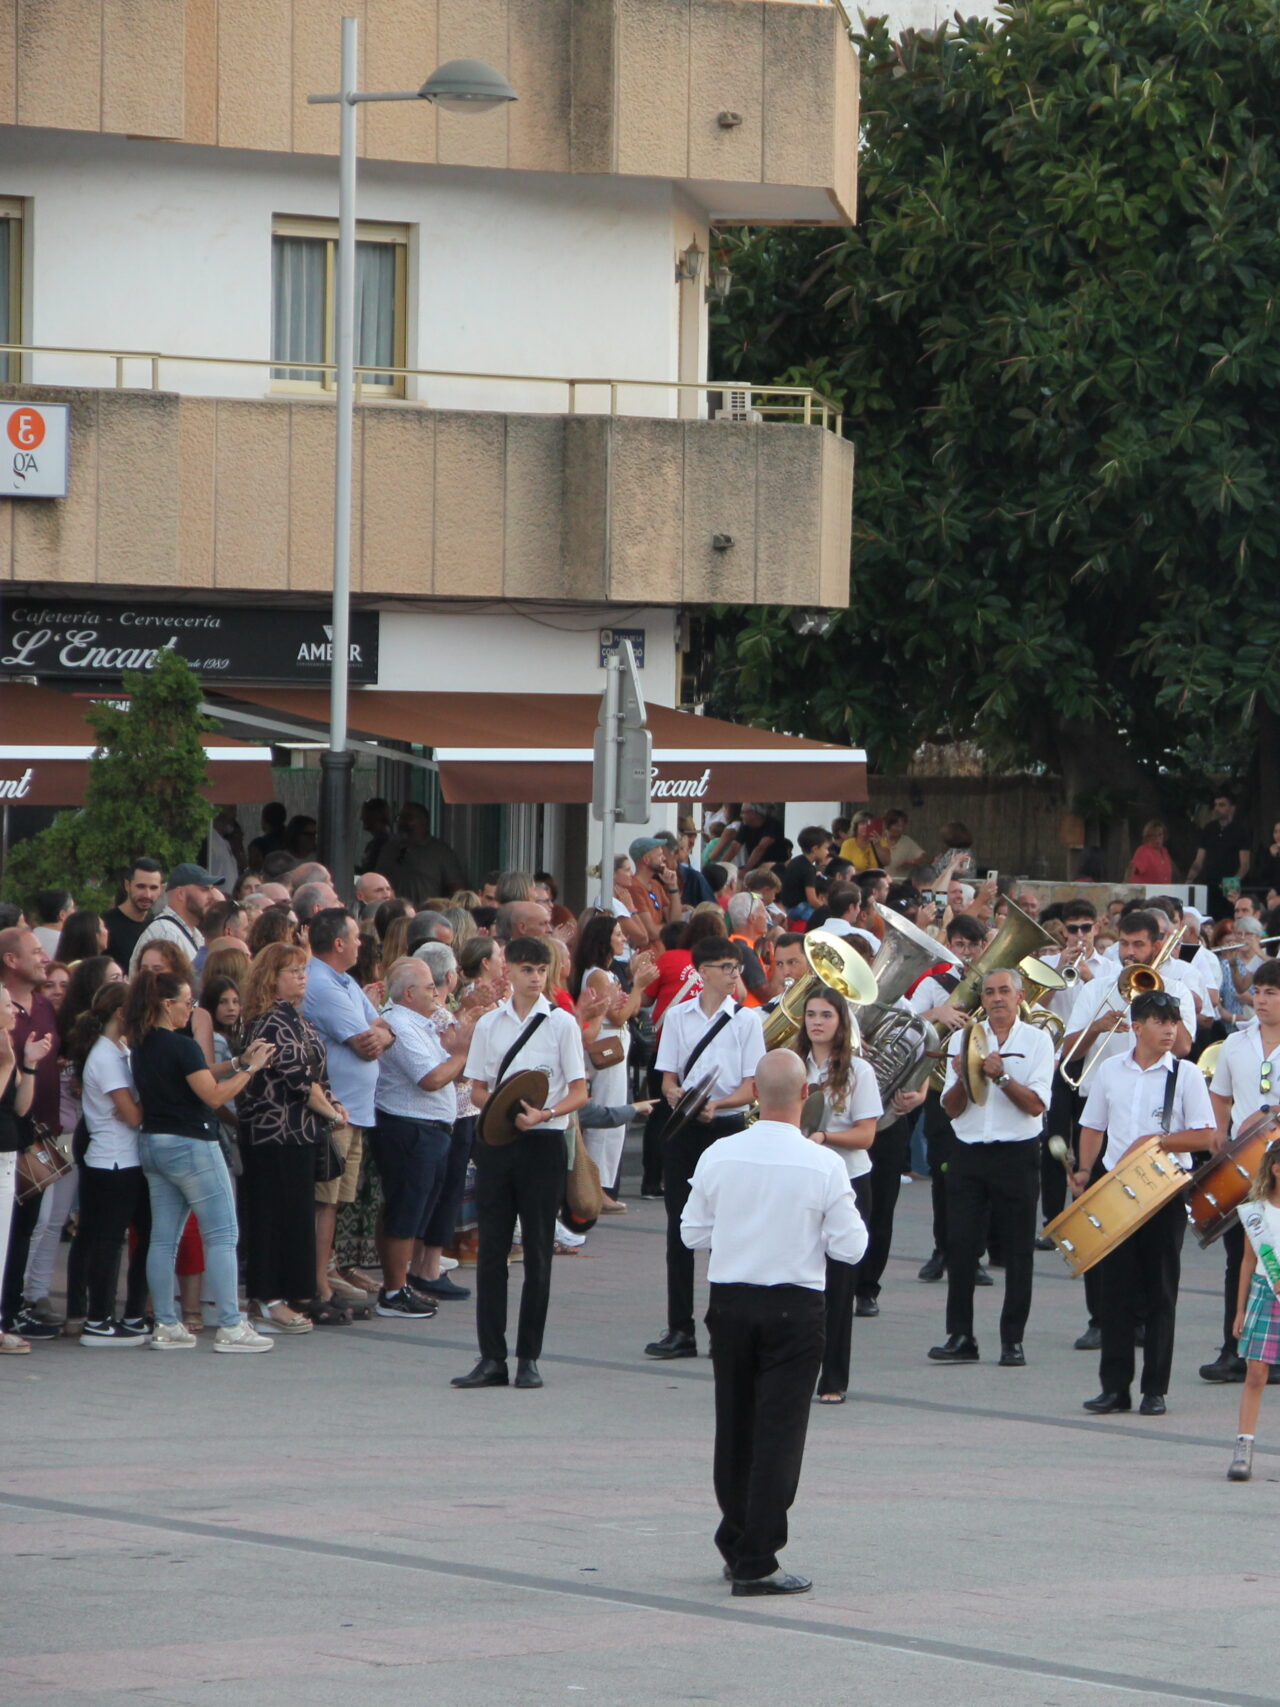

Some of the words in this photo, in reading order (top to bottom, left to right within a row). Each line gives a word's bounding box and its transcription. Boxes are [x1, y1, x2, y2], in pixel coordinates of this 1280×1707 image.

[11, 608, 100, 625] Cafetería
[119, 611, 221, 628] Cervecería
[202, 657, 230, 670] 1989
